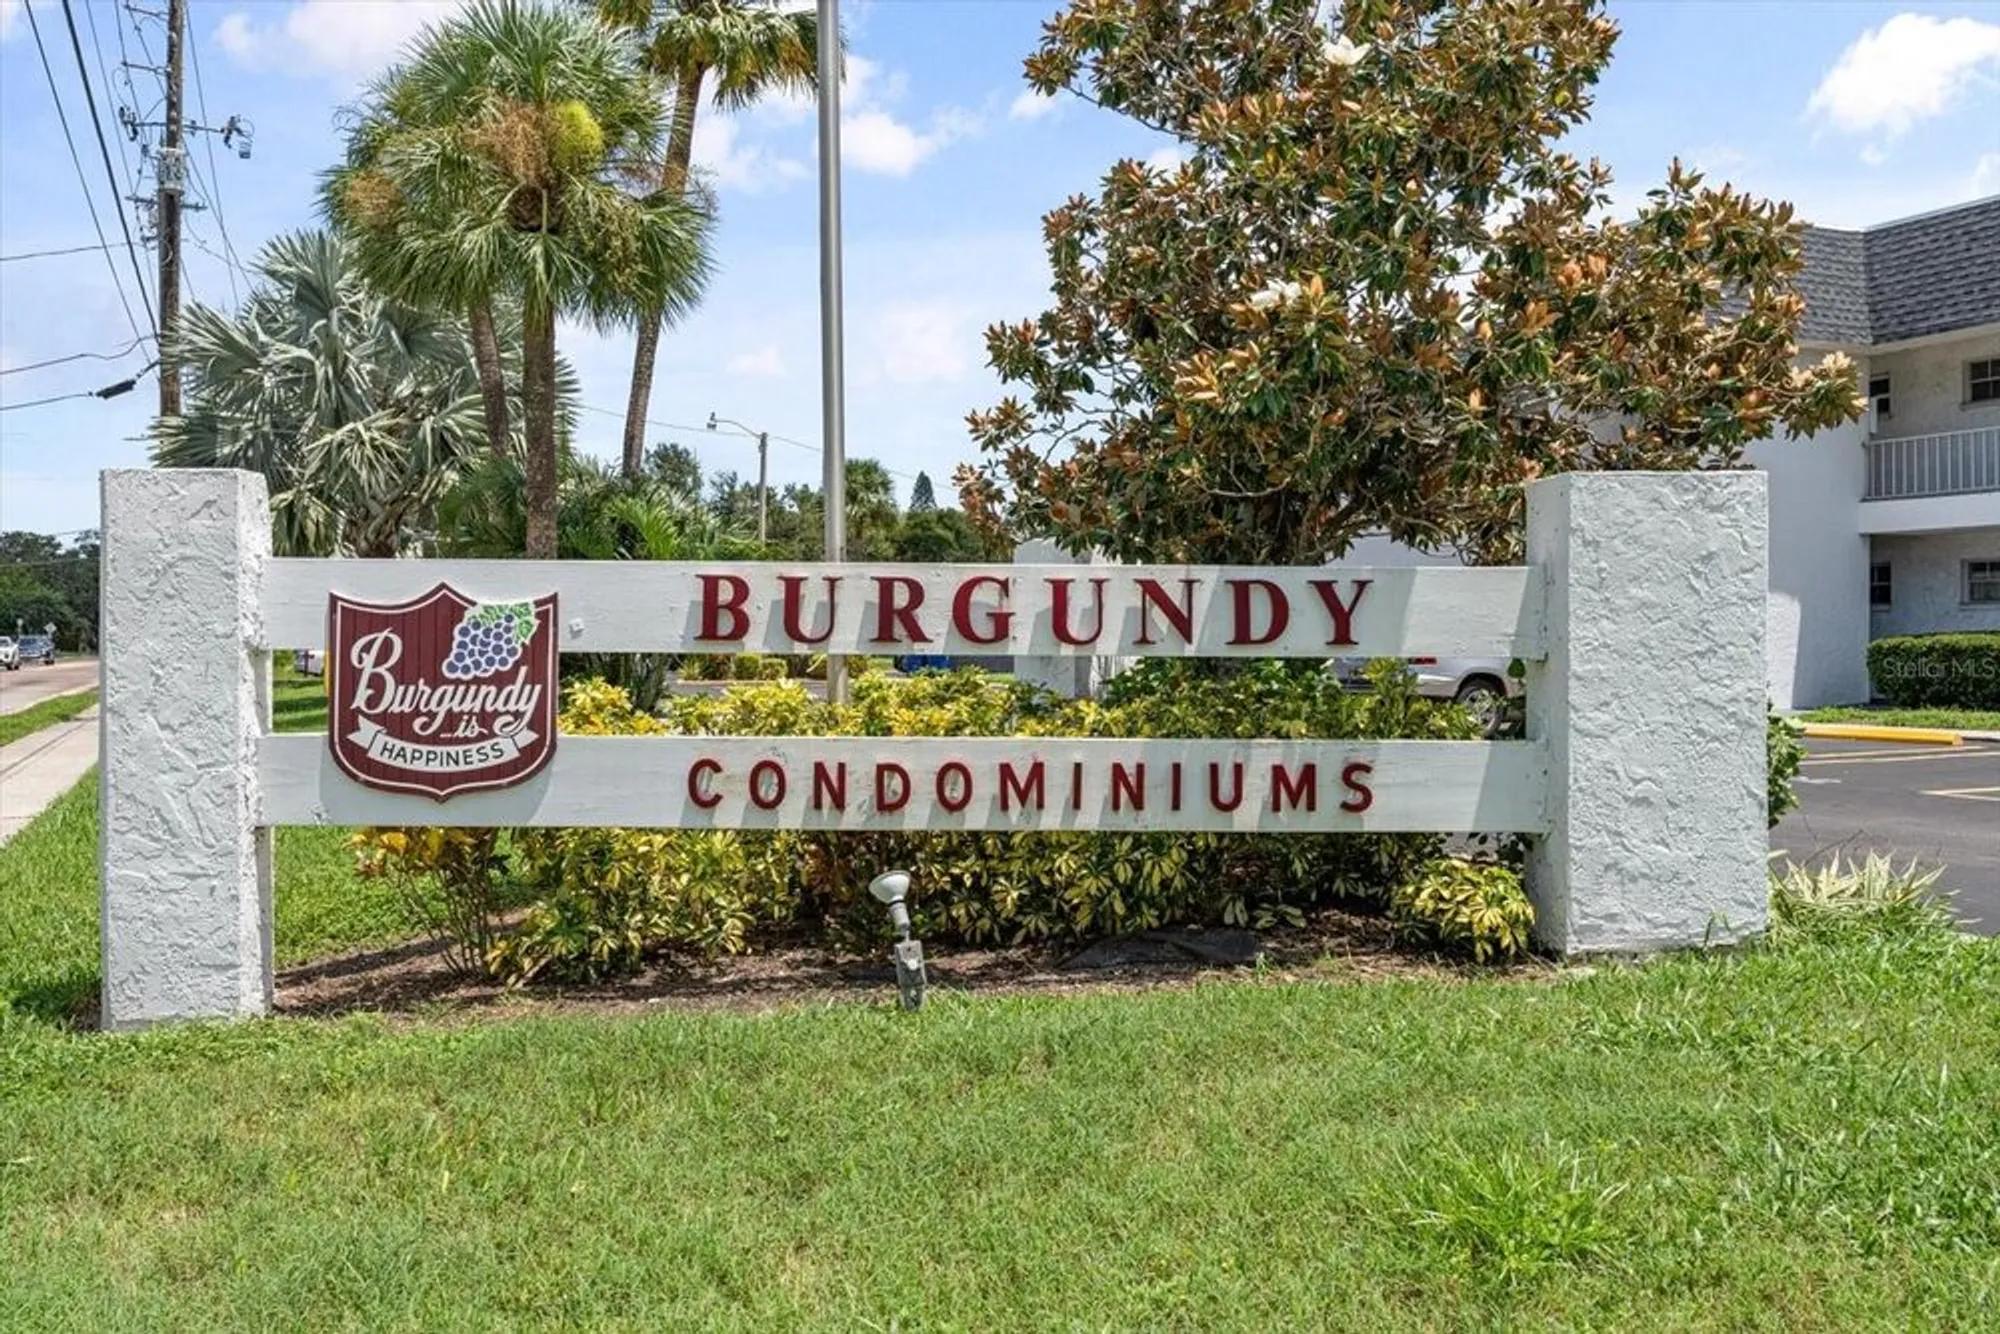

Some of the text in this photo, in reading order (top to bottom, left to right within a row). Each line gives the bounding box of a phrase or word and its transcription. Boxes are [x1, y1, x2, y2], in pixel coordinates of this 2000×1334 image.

[694, 574, 1373, 646] BURGUNDY
[350, 627, 542, 737] Burgundy
[379, 741, 505, 767] HAPPINESS
[448, 714, 486, 738] is
[687, 758, 1375, 814] CONDOMINIUMS
